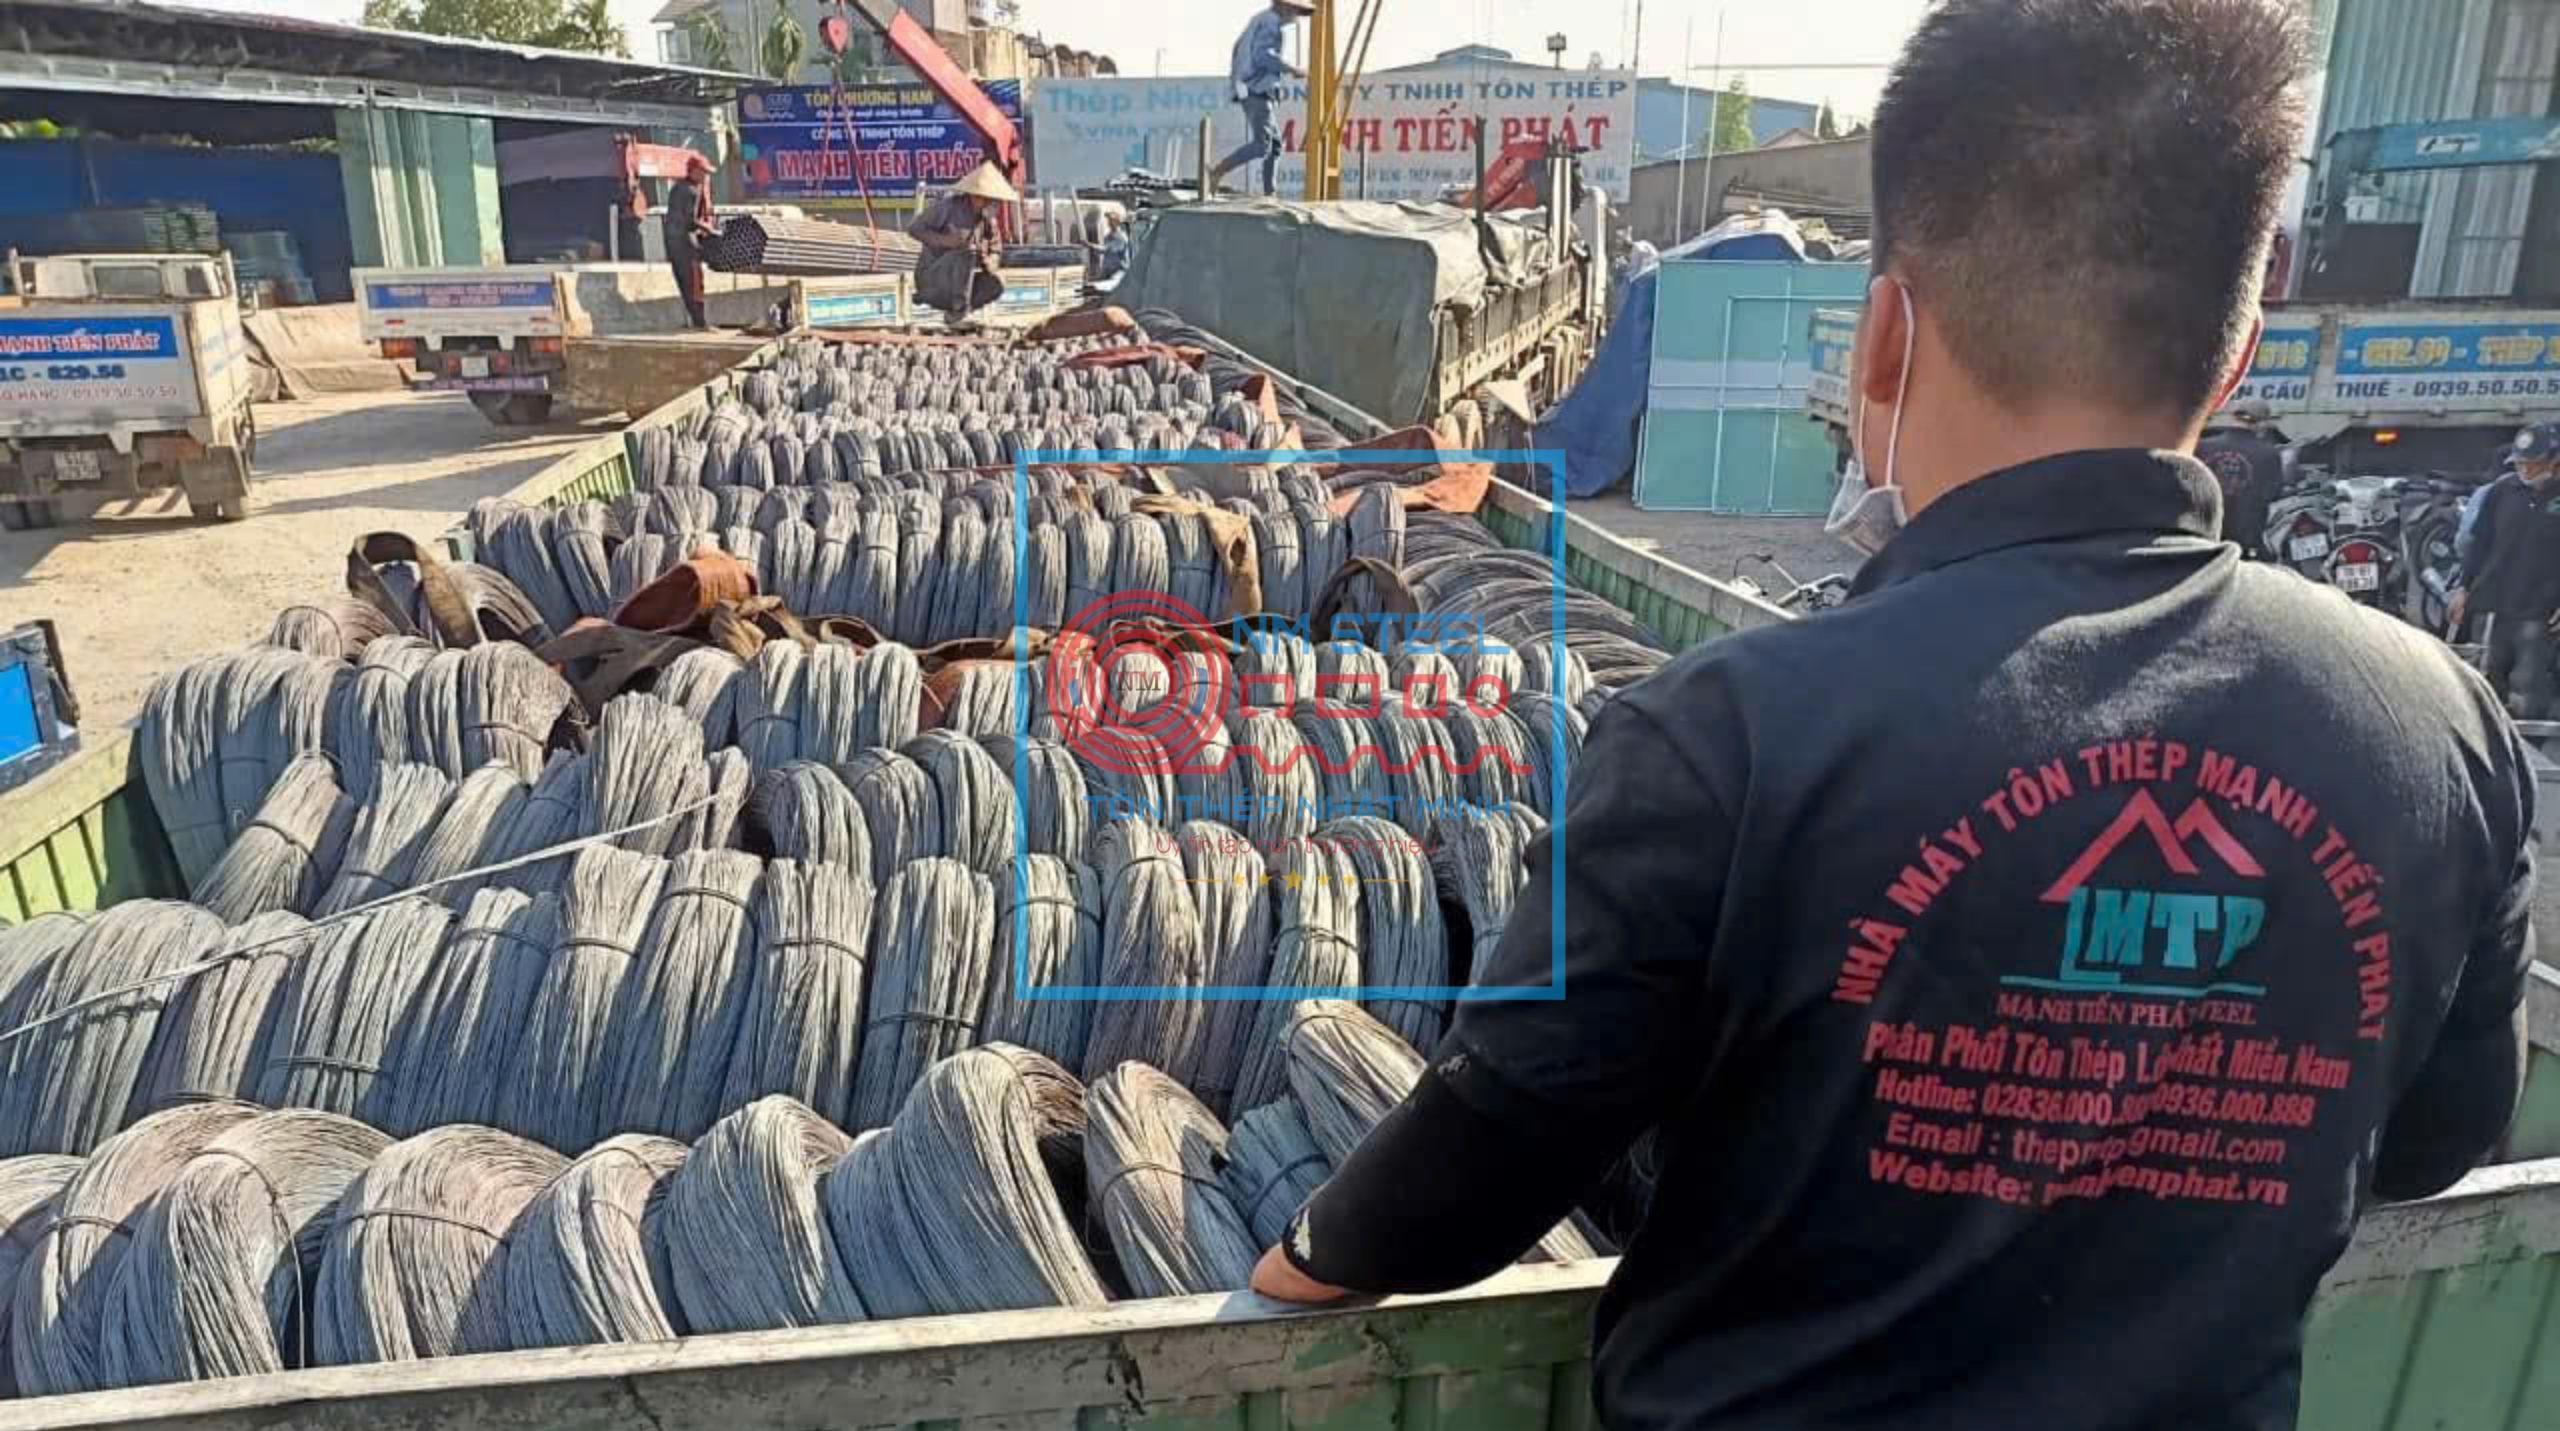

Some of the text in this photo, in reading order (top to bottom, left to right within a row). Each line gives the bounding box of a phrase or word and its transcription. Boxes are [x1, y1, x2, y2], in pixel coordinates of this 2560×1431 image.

[1386, 83, 1464, 100] TNHH
[1475, 77, 1535, 99] TÔN
[1546, 75, 1628, 98] THÉP
[777, 149, 851, 187] MẠNH
[856, 139, 912, 180] TIẾN
[1831, 731, 2391, 1041] NHÀ MÁY TÔN THÉP MẠNH TIẾN PHÁT
[1996, 992, 2073, 1026] MẠNH
[2075, 991, 2127, 1025] TIẾN
[2130, 999, 2193, 1028] PHÁ
[1863, 1021, 1936, 1064] Phân
[1941, 1024, 2009, 1072] Phối
[2014, 1031, 2065, 1080] Tôn
[2070, 1034, 2127, 1090] Thép
[2292, 1041, 2351, 1089] Nam
[1875, 1068, 1977, 1114] Hotline:
[1886, 1111, 1984, 1154] Email
[1869, 1147, 2033, 1205] Website:
